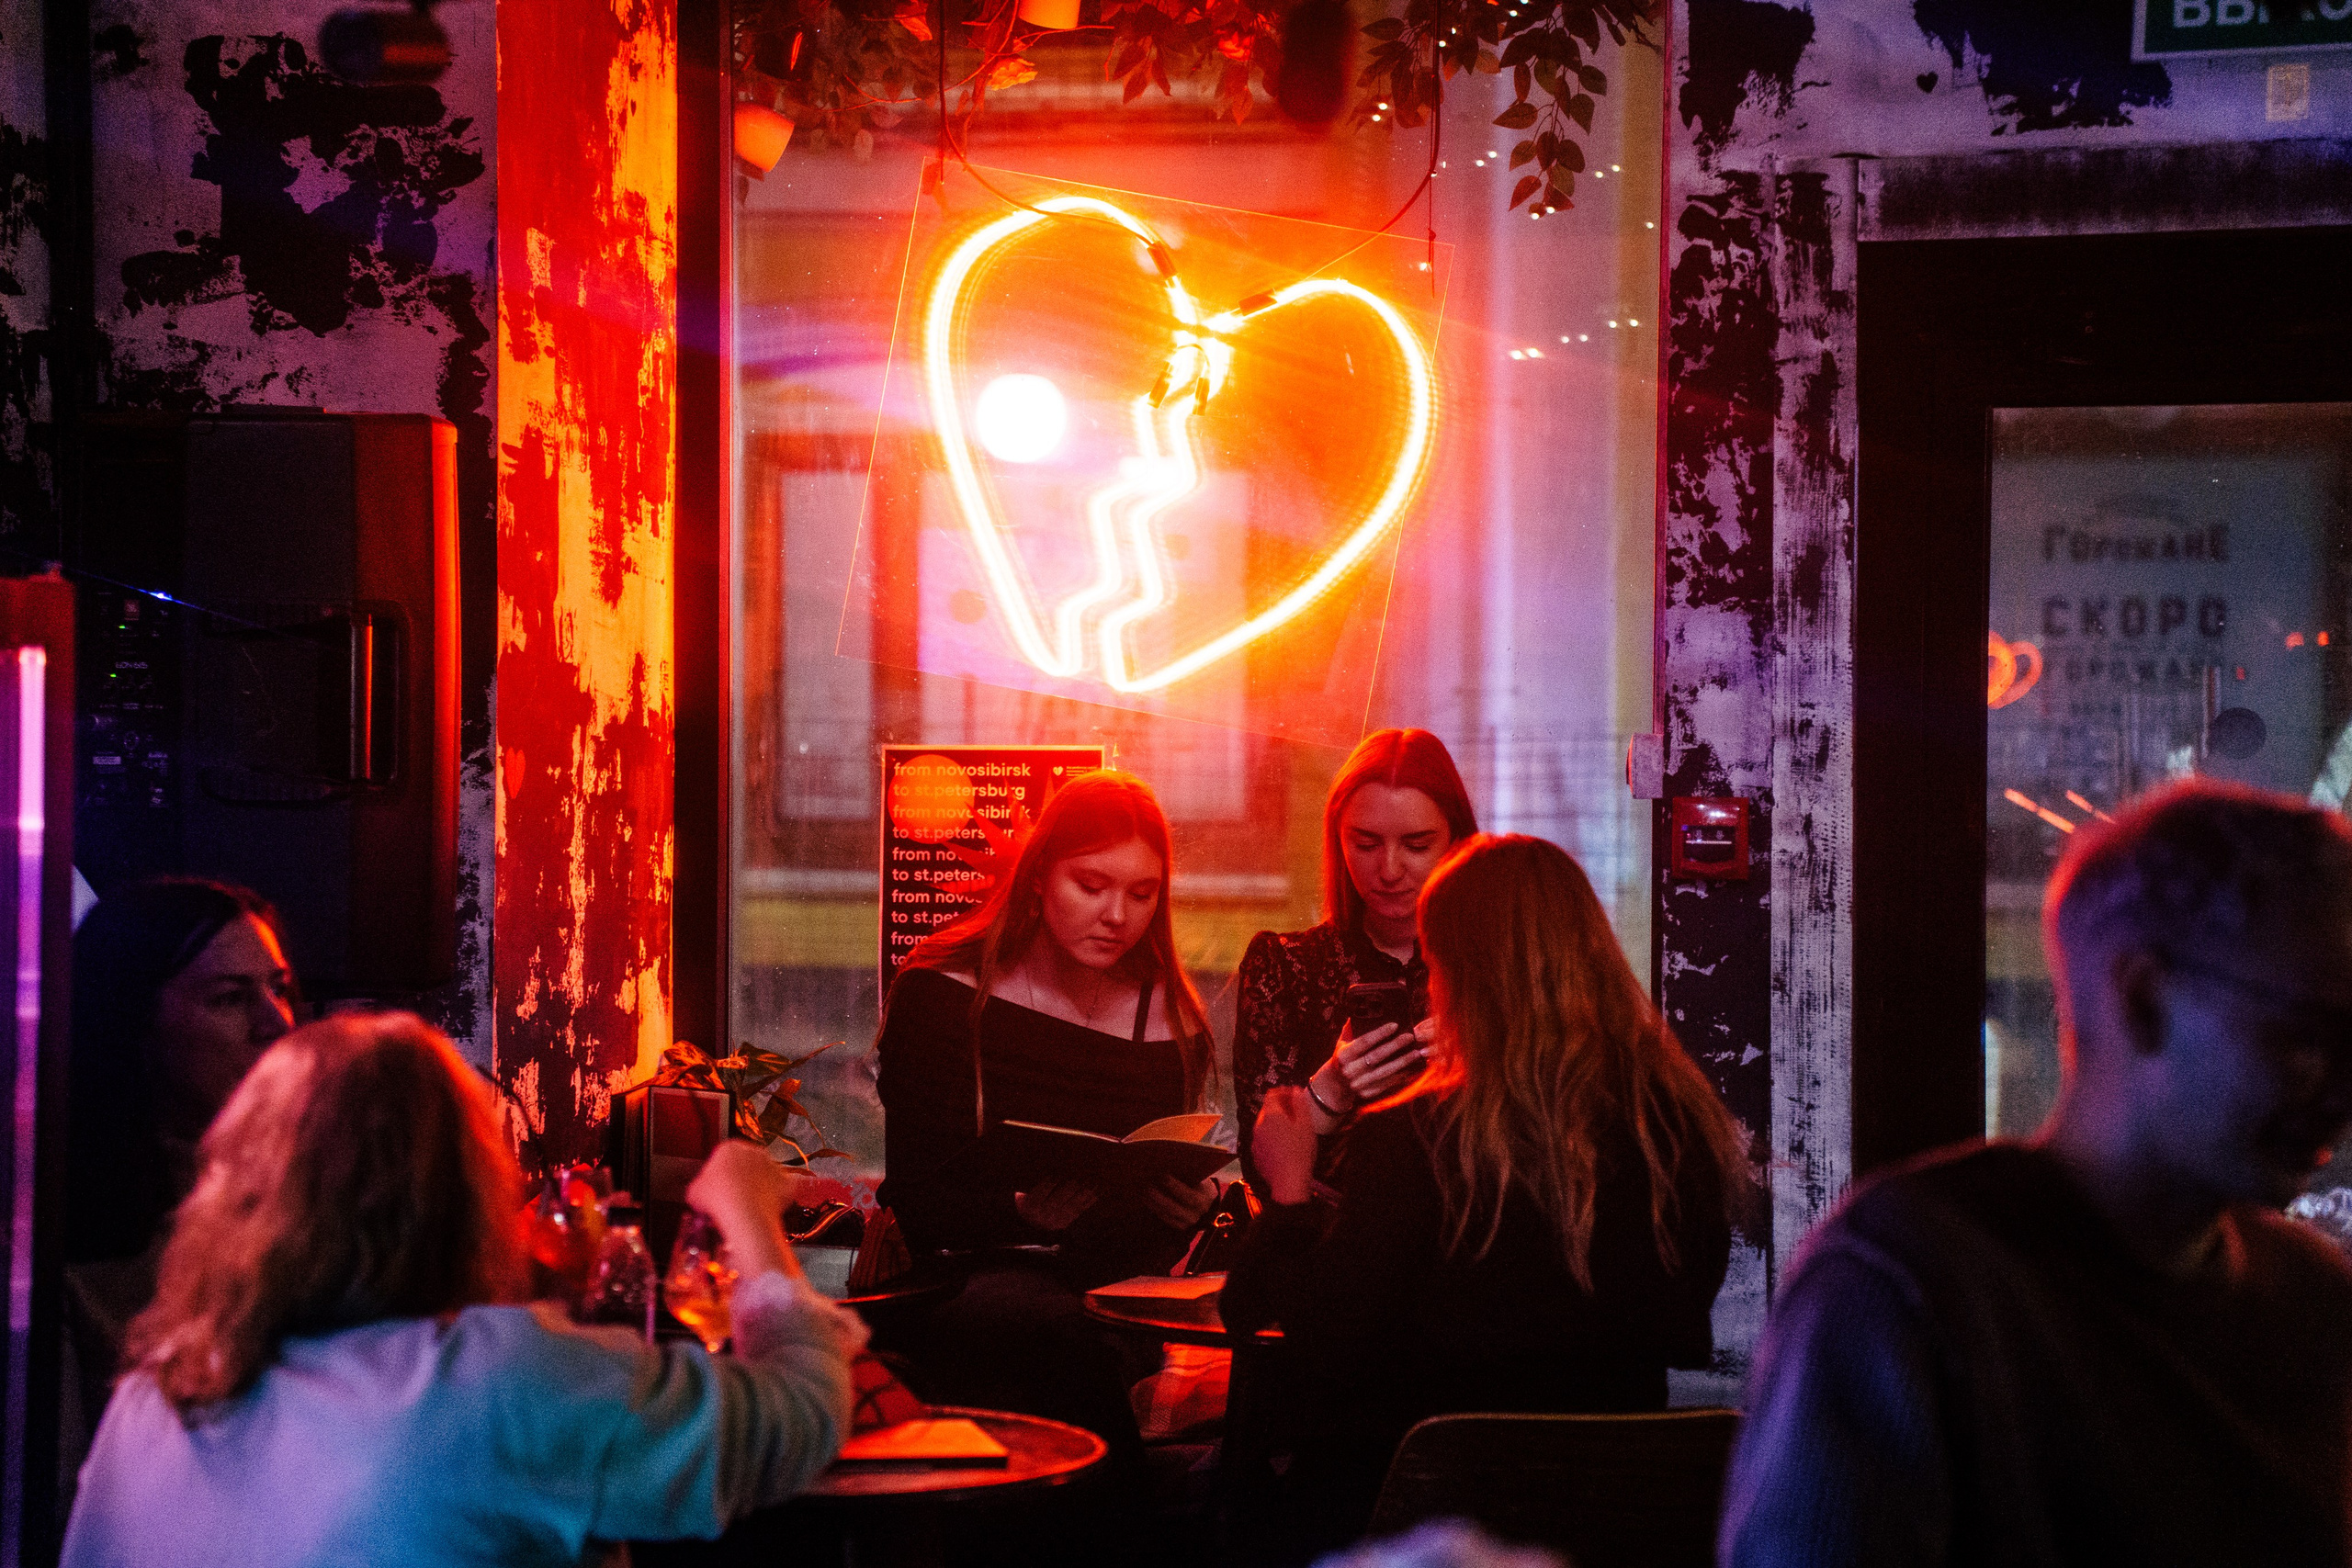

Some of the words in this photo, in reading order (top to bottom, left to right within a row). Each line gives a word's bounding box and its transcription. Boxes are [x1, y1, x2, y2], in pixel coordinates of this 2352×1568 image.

[893, 761, 931, 776] from
[936, 762, 1031, 777] novosibirsk
[893, 784, 910, 796] to
[892, 805, 932, 818] from
[936, 805, 1031, 819] novosibirk
[892, 828, 910, 840] to
[892, 847, 931, 862] from
[892, 869, 910, 881] to
[891, 889, 930, 903] from
[891, 911, 909, 924] to
